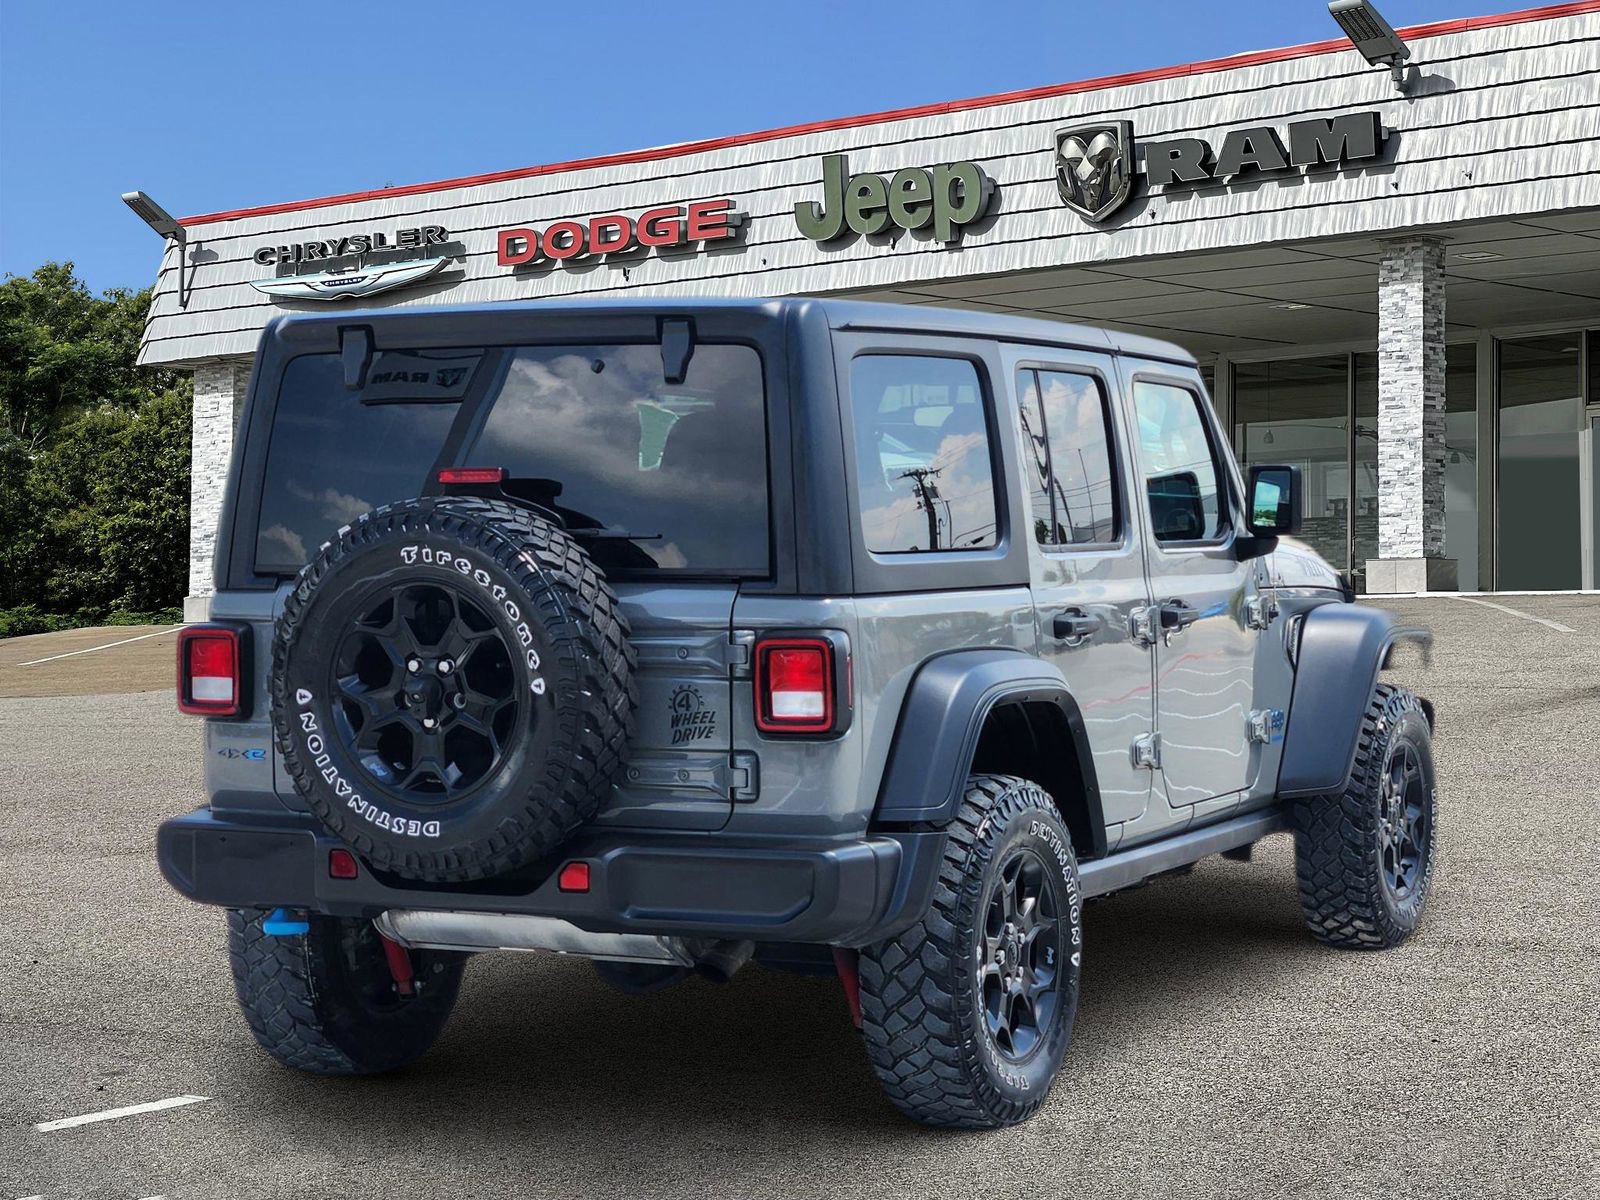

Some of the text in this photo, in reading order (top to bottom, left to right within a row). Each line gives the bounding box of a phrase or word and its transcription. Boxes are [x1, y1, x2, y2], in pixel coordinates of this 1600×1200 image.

[1145, 111, 1380, 186] RAM
[497, 199, 736, 266] DODGE
[794, 154, 984, 242] Jeep
[253, 224, 448, 266] CHRYSLER
[401, 546, 540, 670] Firestone
[671, 711, 716, 729] WHEEL
[671, 726, 716, 745] DRIVE
[300, 711, 440, 838] DESTINATION
[1029, 820, 1081, 945] DESTINATION
